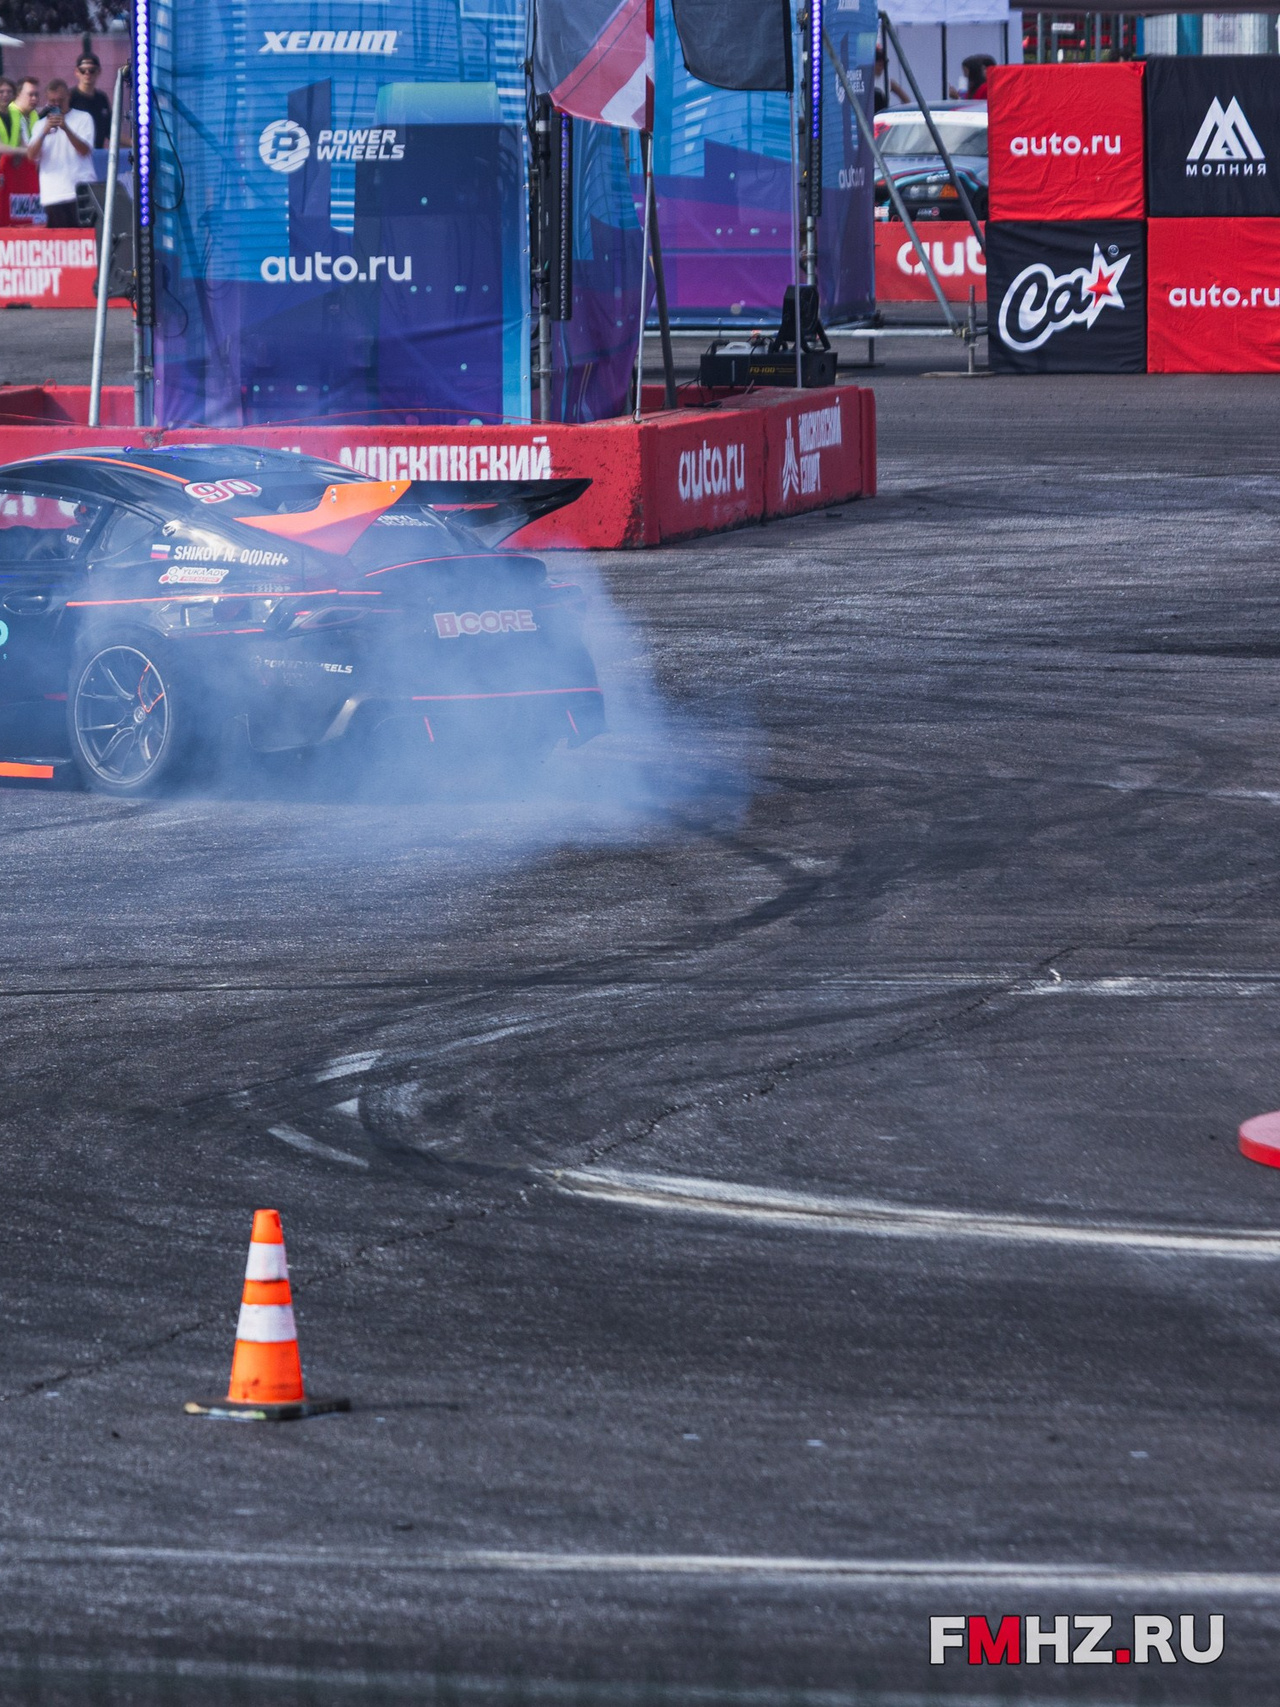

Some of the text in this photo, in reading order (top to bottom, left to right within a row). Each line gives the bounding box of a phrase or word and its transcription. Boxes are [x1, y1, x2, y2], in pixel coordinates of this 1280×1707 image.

[259, 30, 399, 54] XENUM
[317, 129, 396, 144] POWER
[1010, 132, 1121, 155] auto.ru
[316, 144, 406, 160] WHEELS
[1186, 163, 1267, 177] МОЛНИЯ
[261, 252, 412, 283] auto.ru
[1168, 284, 1280, 307] auto.ru
[339, 437, 552, 481] МОСКОВСКИЙ
[678, 440, 745, 501] auto.ru
[184, 479, 262, 504] 90
[174, 545, 220, 562] SHIKOV
[223, 550, 236, 563] N.
